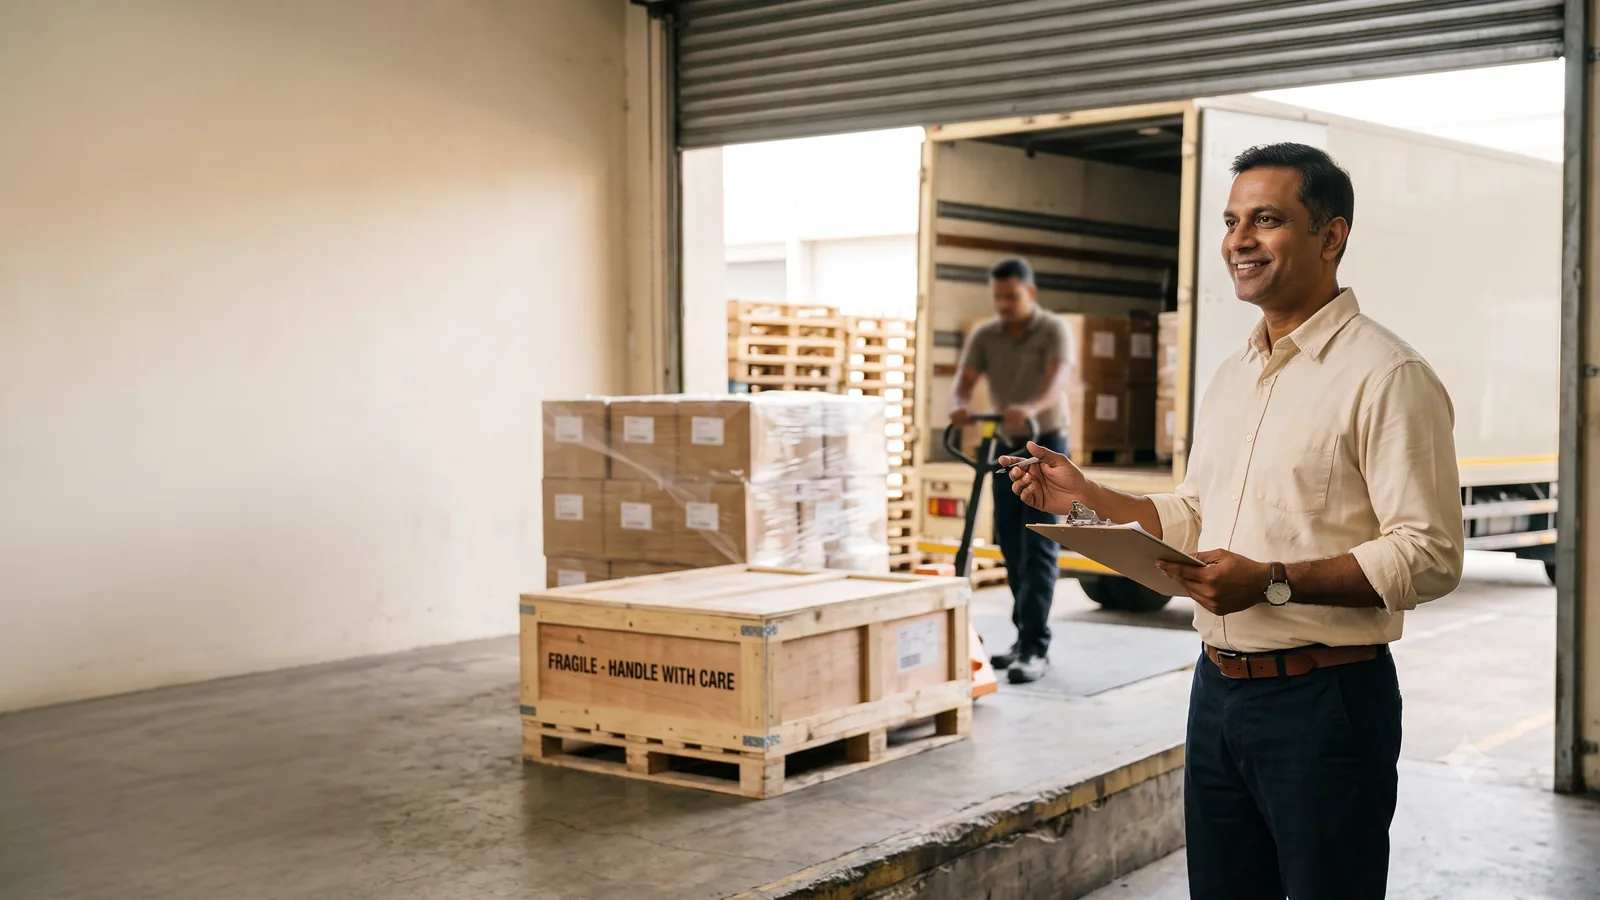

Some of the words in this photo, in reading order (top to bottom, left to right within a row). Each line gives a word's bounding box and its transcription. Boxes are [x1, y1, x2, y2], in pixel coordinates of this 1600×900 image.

[548, 652, 597, 674] FRAGILE
[608, 659, 658, 681] HANDLE
[662, 665, 695, 686] WITH
[700, 669, 735, 690] CARE
